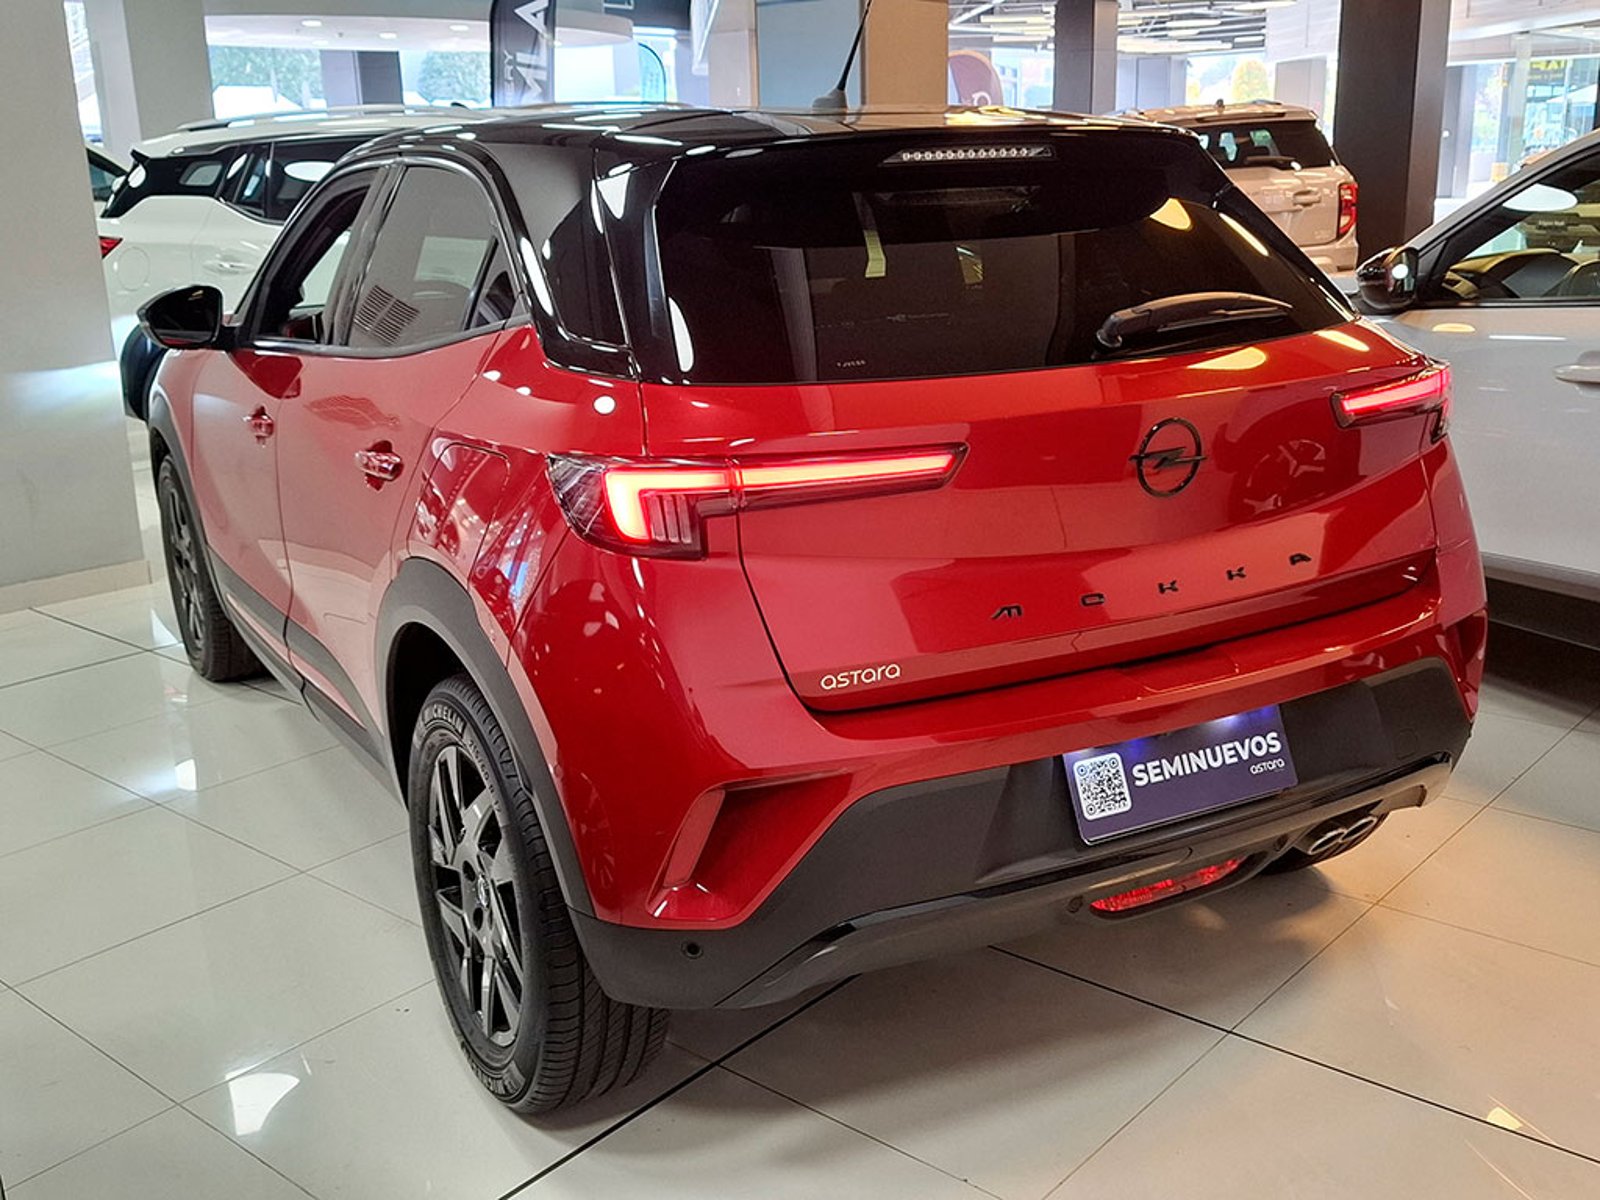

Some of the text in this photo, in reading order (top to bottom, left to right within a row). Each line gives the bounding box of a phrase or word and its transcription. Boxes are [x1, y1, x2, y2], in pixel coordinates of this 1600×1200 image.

[820, 663, 901, 690] astara
[1131, 731, 1282, 787] SEMINUEVOS
[1250, 758, 1285, 776] astara
